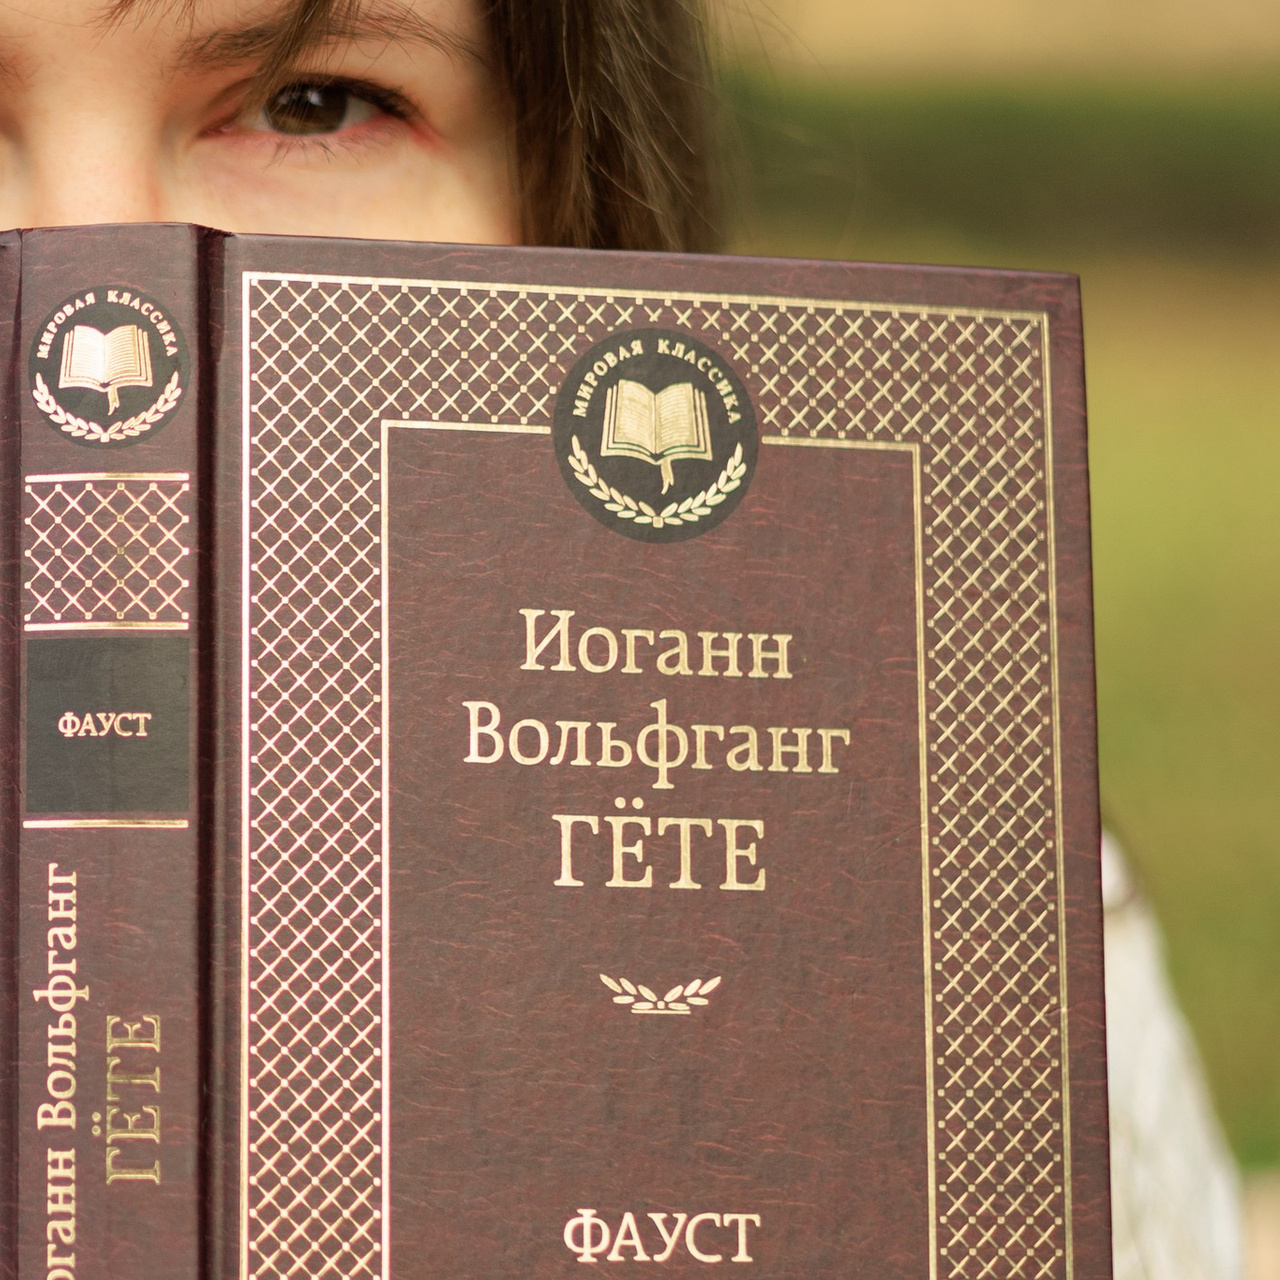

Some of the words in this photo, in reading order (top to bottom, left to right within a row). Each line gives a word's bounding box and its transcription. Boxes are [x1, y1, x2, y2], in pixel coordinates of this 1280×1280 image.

[36, 291, 96, 359] МИРОВАЯ
[106, 289, 179, 357] КЛАССИКА
[572, 339, 644, 418] МИРОВАЯ
[656, 337, 742, 425] КЛАССИКА
[518, 608, 793, 680] Иоганн
[57, 711, 152, 738] ФАУСТ
[461, 698, 851, 790] Вольфганг
[551, 796, 768, 892] ГЁТЕ
[32, 861, 90, 1132] Вольфганг
[91, 1013, 162, 1186] ГЁТЕ
[562, 1208, 762, 1265] ФАУСТ
